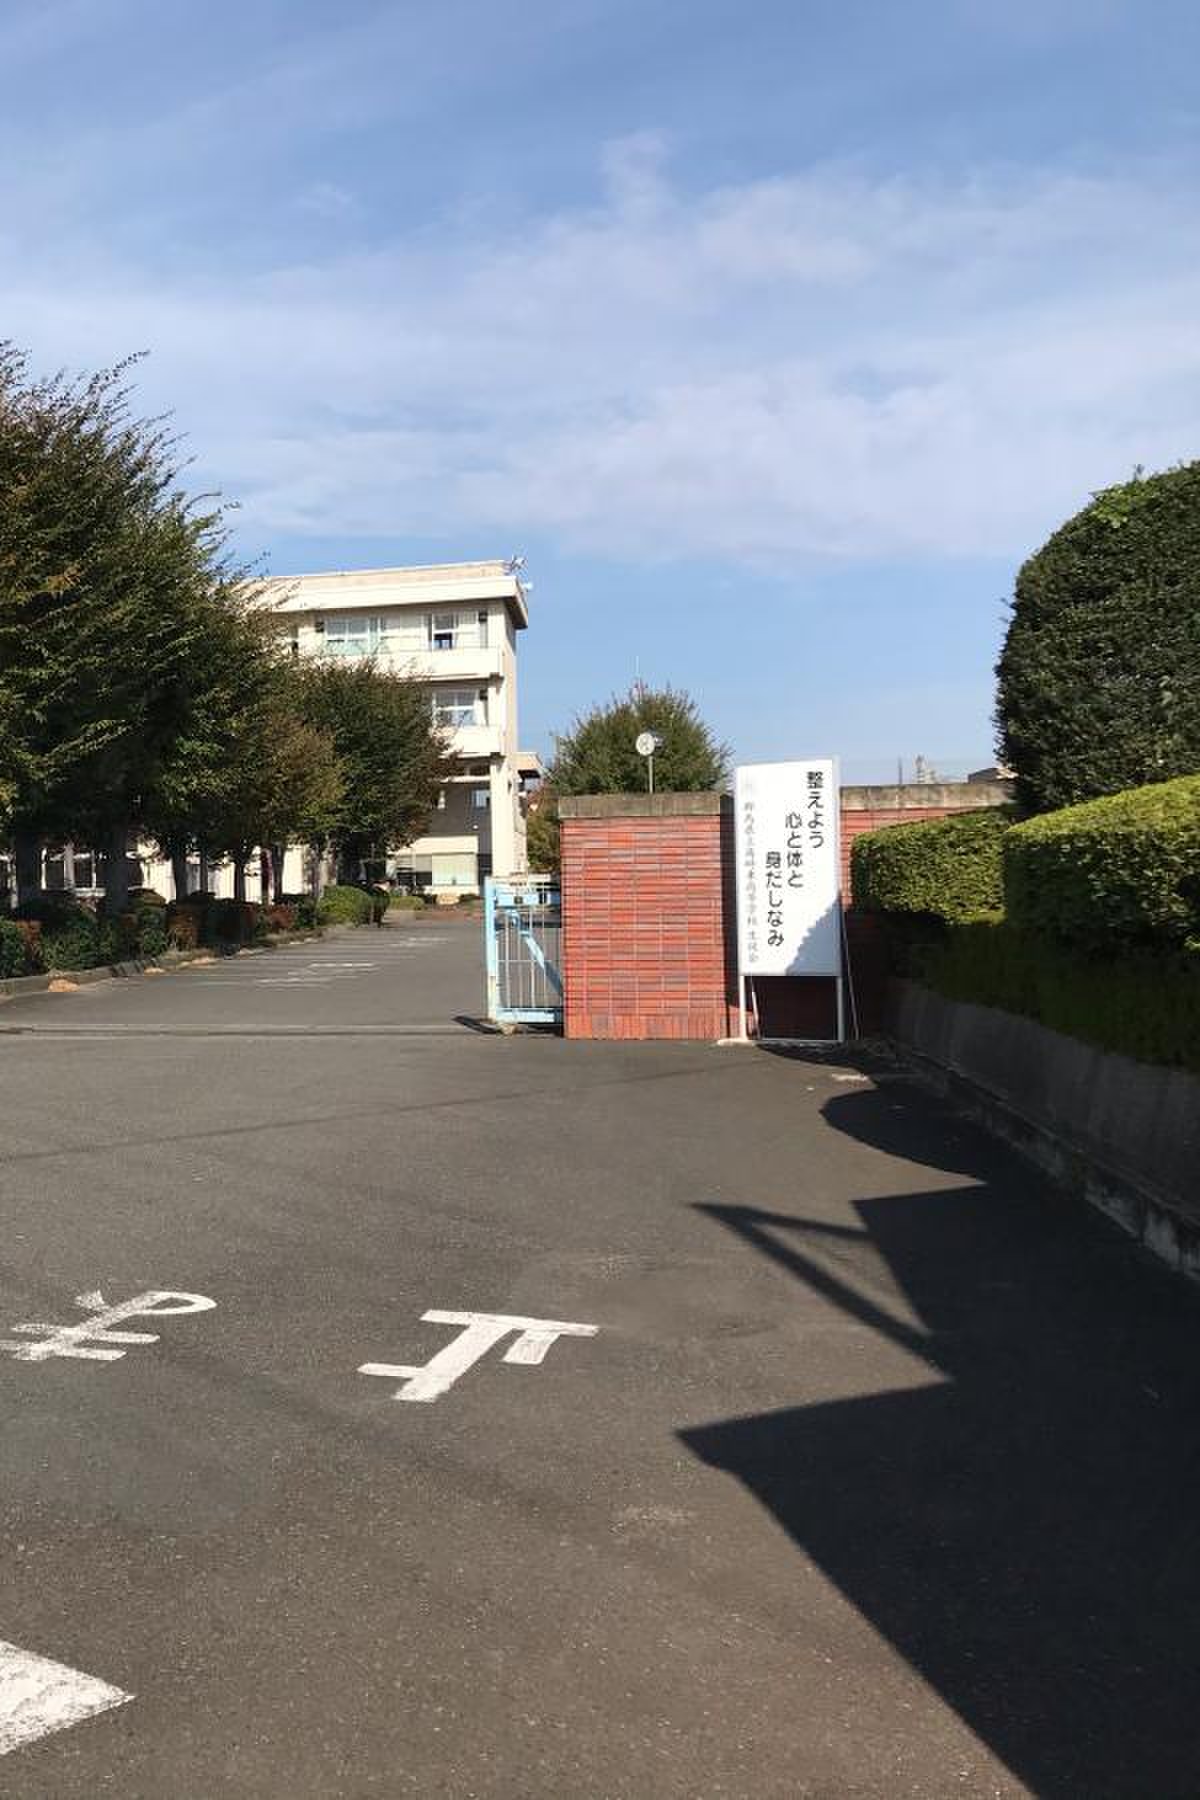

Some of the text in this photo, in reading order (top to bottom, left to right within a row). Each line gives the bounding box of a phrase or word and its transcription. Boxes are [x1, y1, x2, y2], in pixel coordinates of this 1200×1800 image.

[806, 770, 825, 849] 整えよう
[785, 811, 804, 889] 心と体と
[765, 850, 785, 947] 身だしなみ
